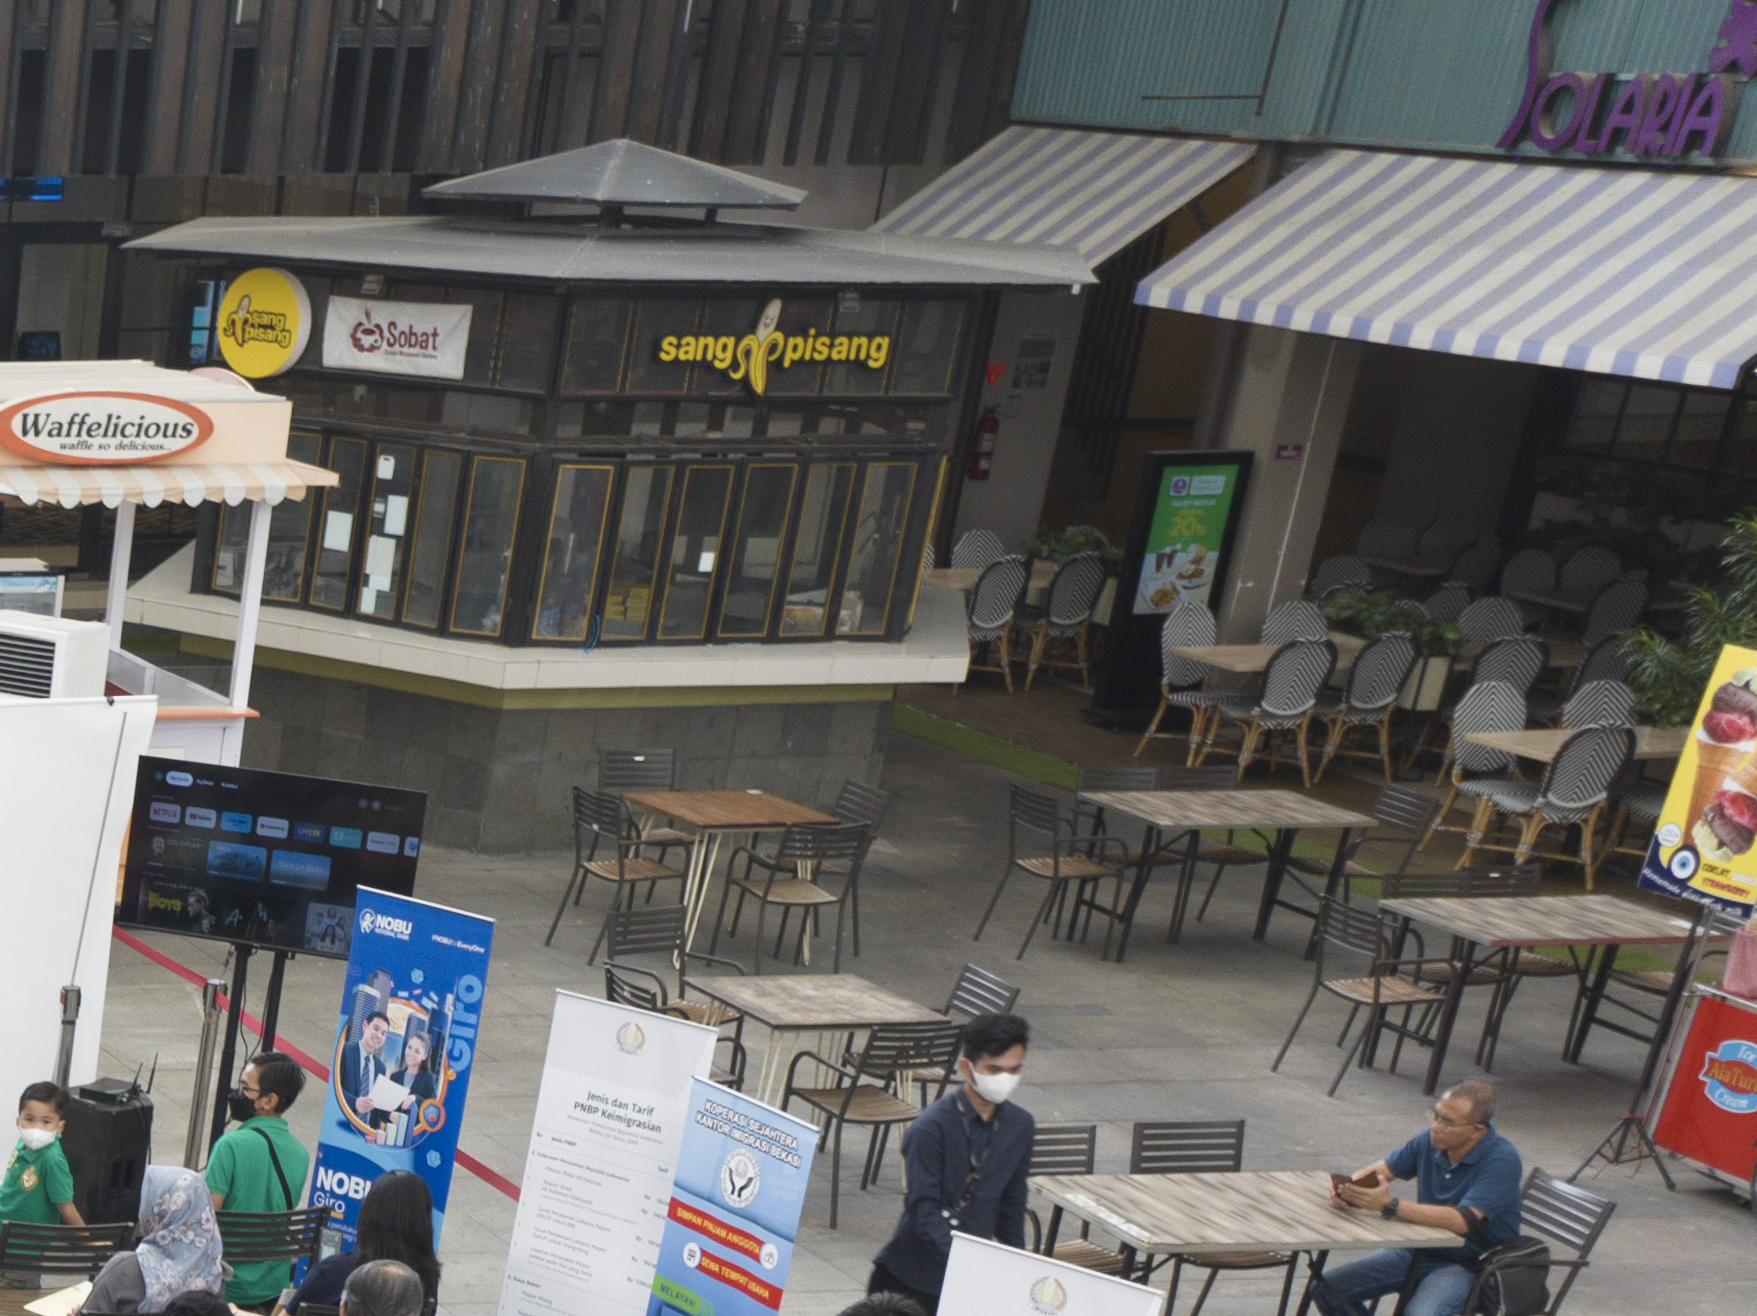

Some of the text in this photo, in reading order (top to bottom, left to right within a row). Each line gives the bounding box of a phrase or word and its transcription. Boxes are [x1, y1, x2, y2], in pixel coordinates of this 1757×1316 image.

[251, 311, 286, 330] sang
[245, 325, 292, 349] pisang
[386, 321, 440, 352] Sobat
[659, 327, 890, 370] sang pisang
[19, 412, 195, 438] Waffelicious
[59, 440, 93, 453] waffle
[97, 443, 111, 451] so
[152, 807, 178, 819] NETFLIX
[374, 915, 412, 934] NOBU
[1737, 1045, 1757, 1064] Ice
[587, 1091, 654, 1116] Jenis dan Tarif
[1714, 1086, 1749, 1108] Cream
[574, 1101, 661, 1133] PNBP Keimigrasian
[704, 1099, 797, 1151] KOPERASI SEJAHTERA
[695, 1111, 801, 1169] KANTOR IMIGRASI BEKASI
[314, 1191, 345, 1213] Giro
[677, 1207, 760, 1255] SIMPAN PINJAM ANGGOTA
[699, 1255, 769, 1298] SEWA TEMPAT USAHA
[660, 1284, 695, 1306] MELAYANI
